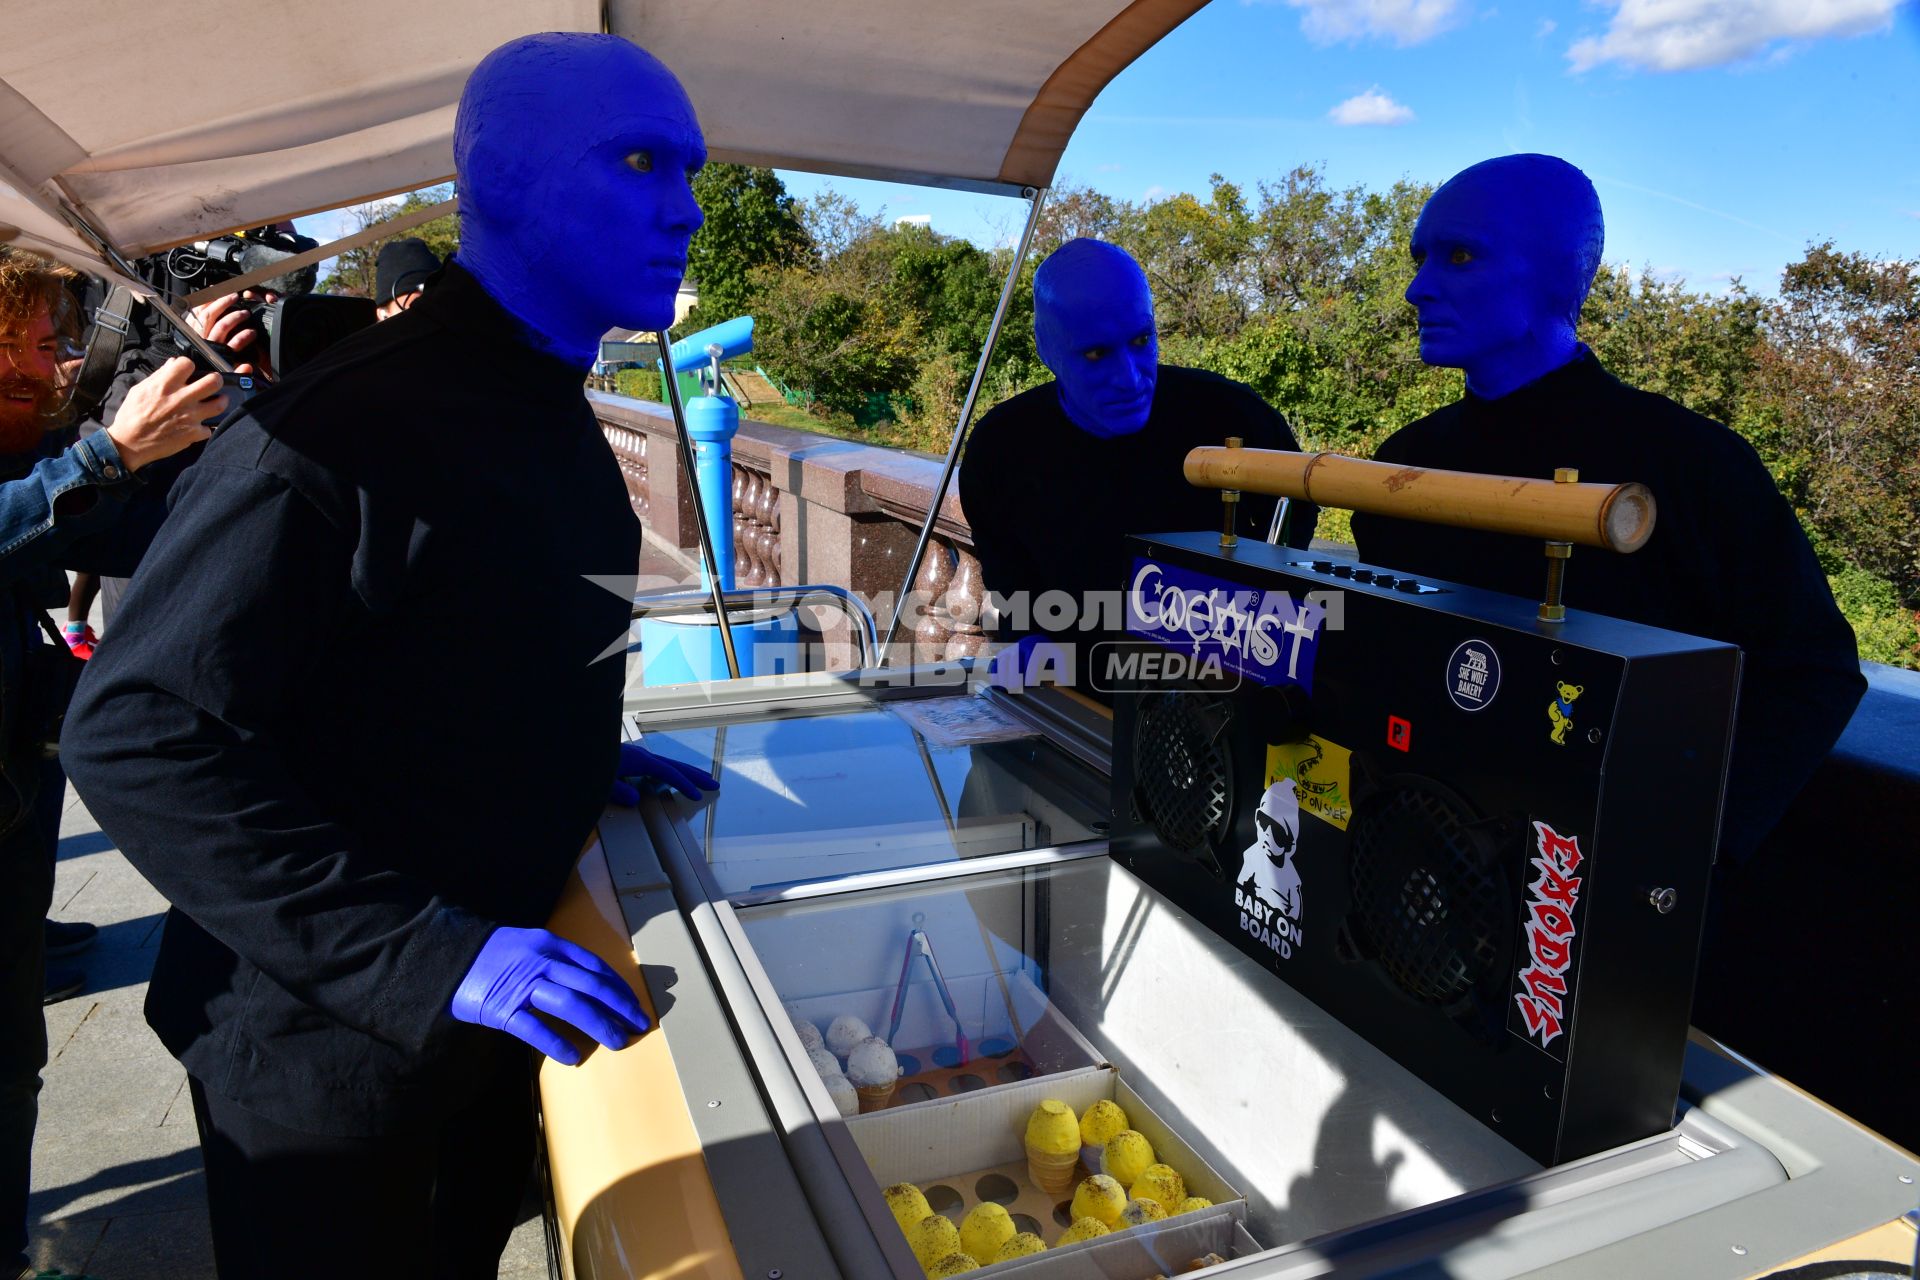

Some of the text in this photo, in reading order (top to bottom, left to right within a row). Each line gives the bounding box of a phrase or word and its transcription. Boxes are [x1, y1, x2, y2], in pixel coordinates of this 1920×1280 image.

[1457, 679, 1483, 698] BAKERY
[1458, 667, 1488, 686] SHE WOLF
[1235, 887, 1303, 948] BABY ON
[1240, 913, 1292, 960] BOARD
[1514, 820, 1585, 1048] EXODUS
